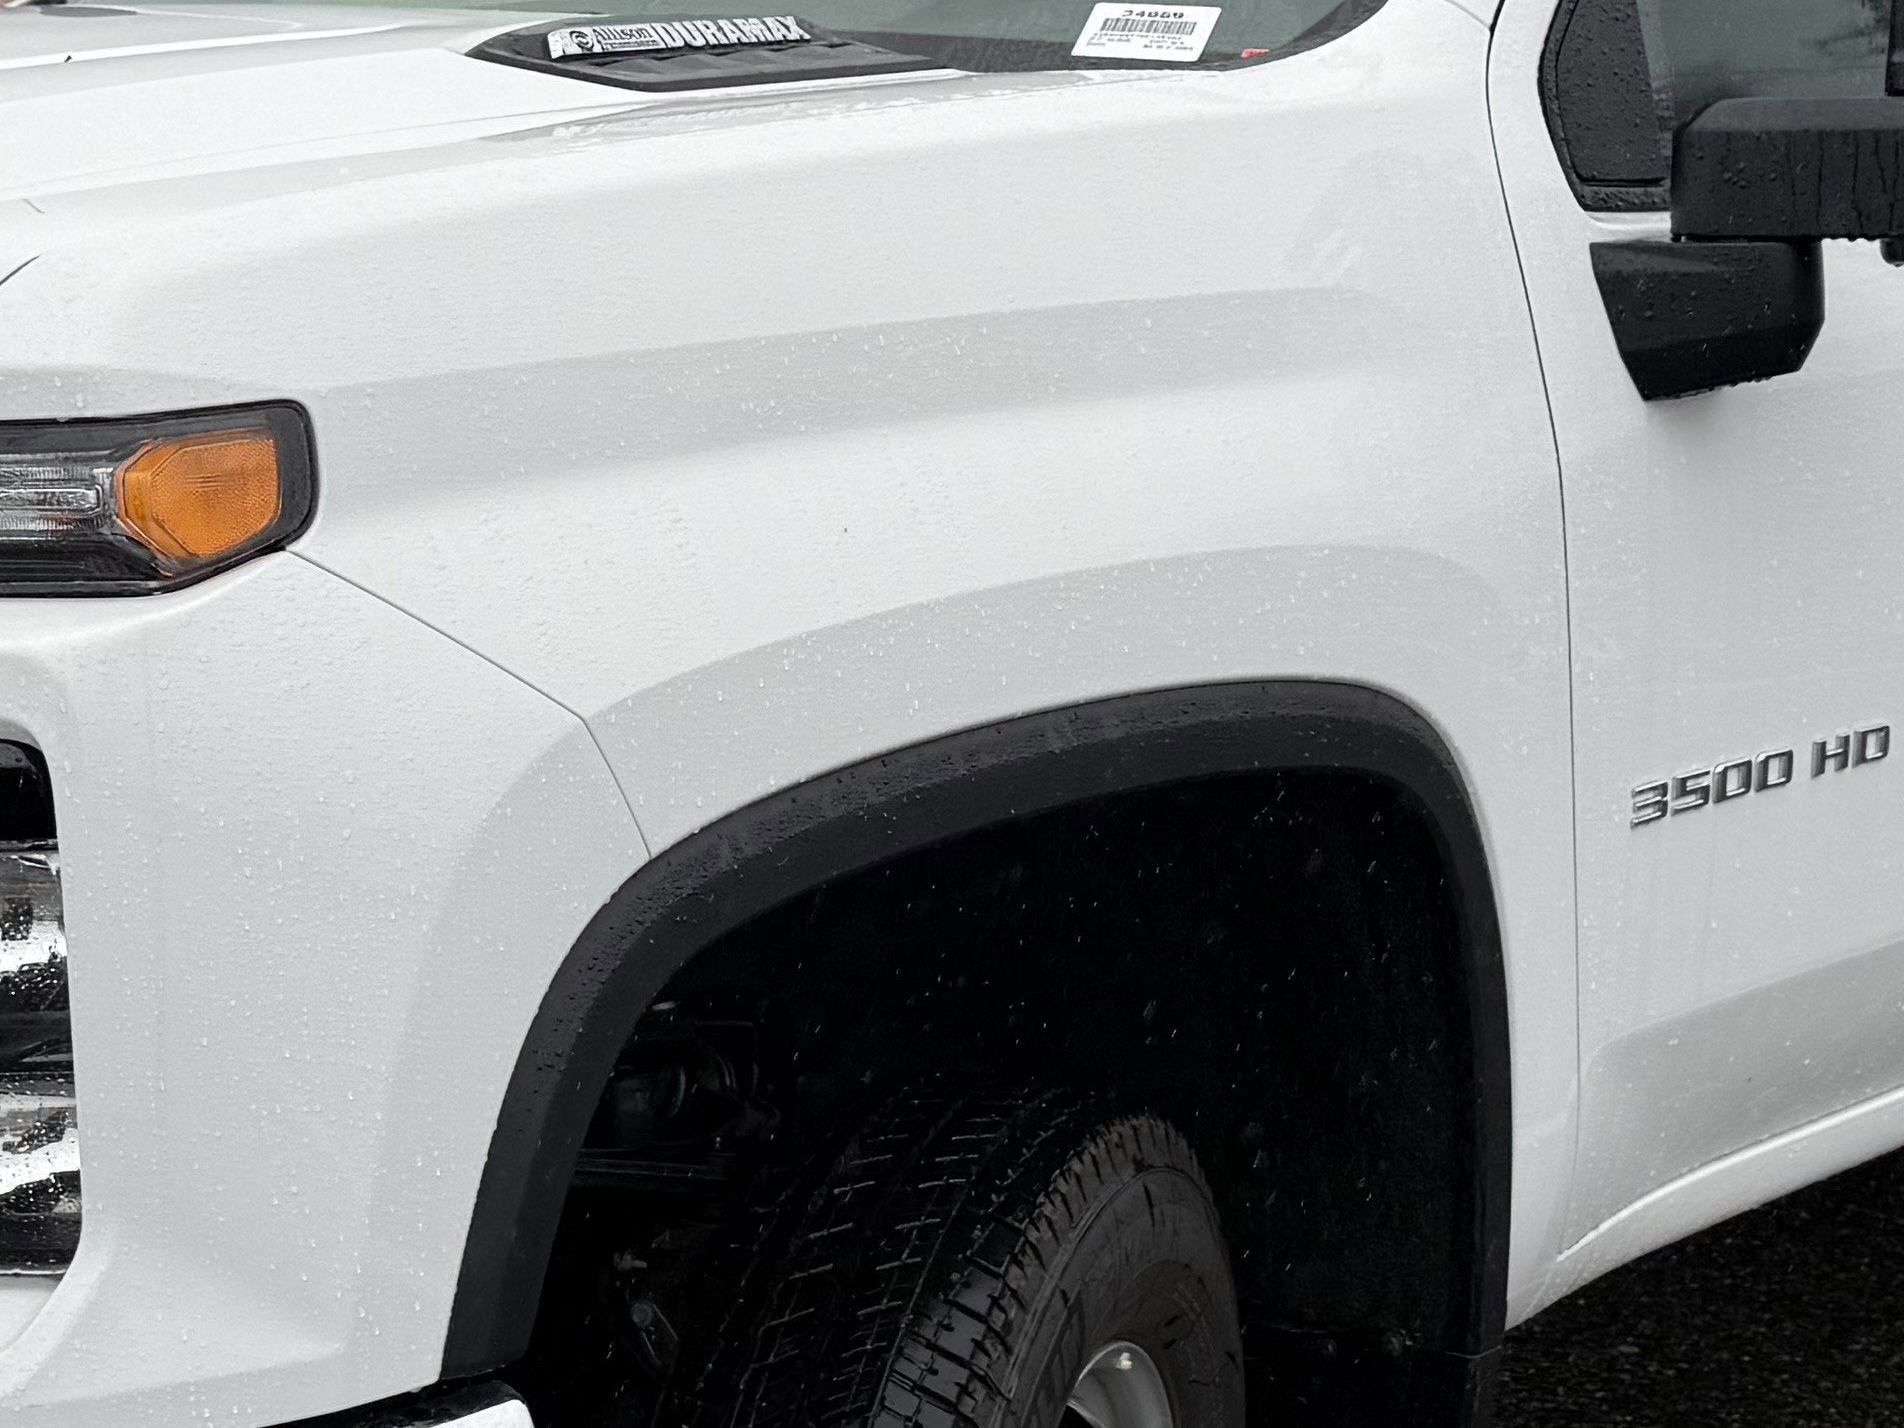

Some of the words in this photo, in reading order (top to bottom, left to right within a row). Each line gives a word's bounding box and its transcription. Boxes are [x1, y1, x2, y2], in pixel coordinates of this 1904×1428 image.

[592, 27, 653, 50] Allison
[656, 16, 811, 49] DURAMAX
[1630, 748, 1794, 829] 3500
[1810, 723, 1891, 779] HD
